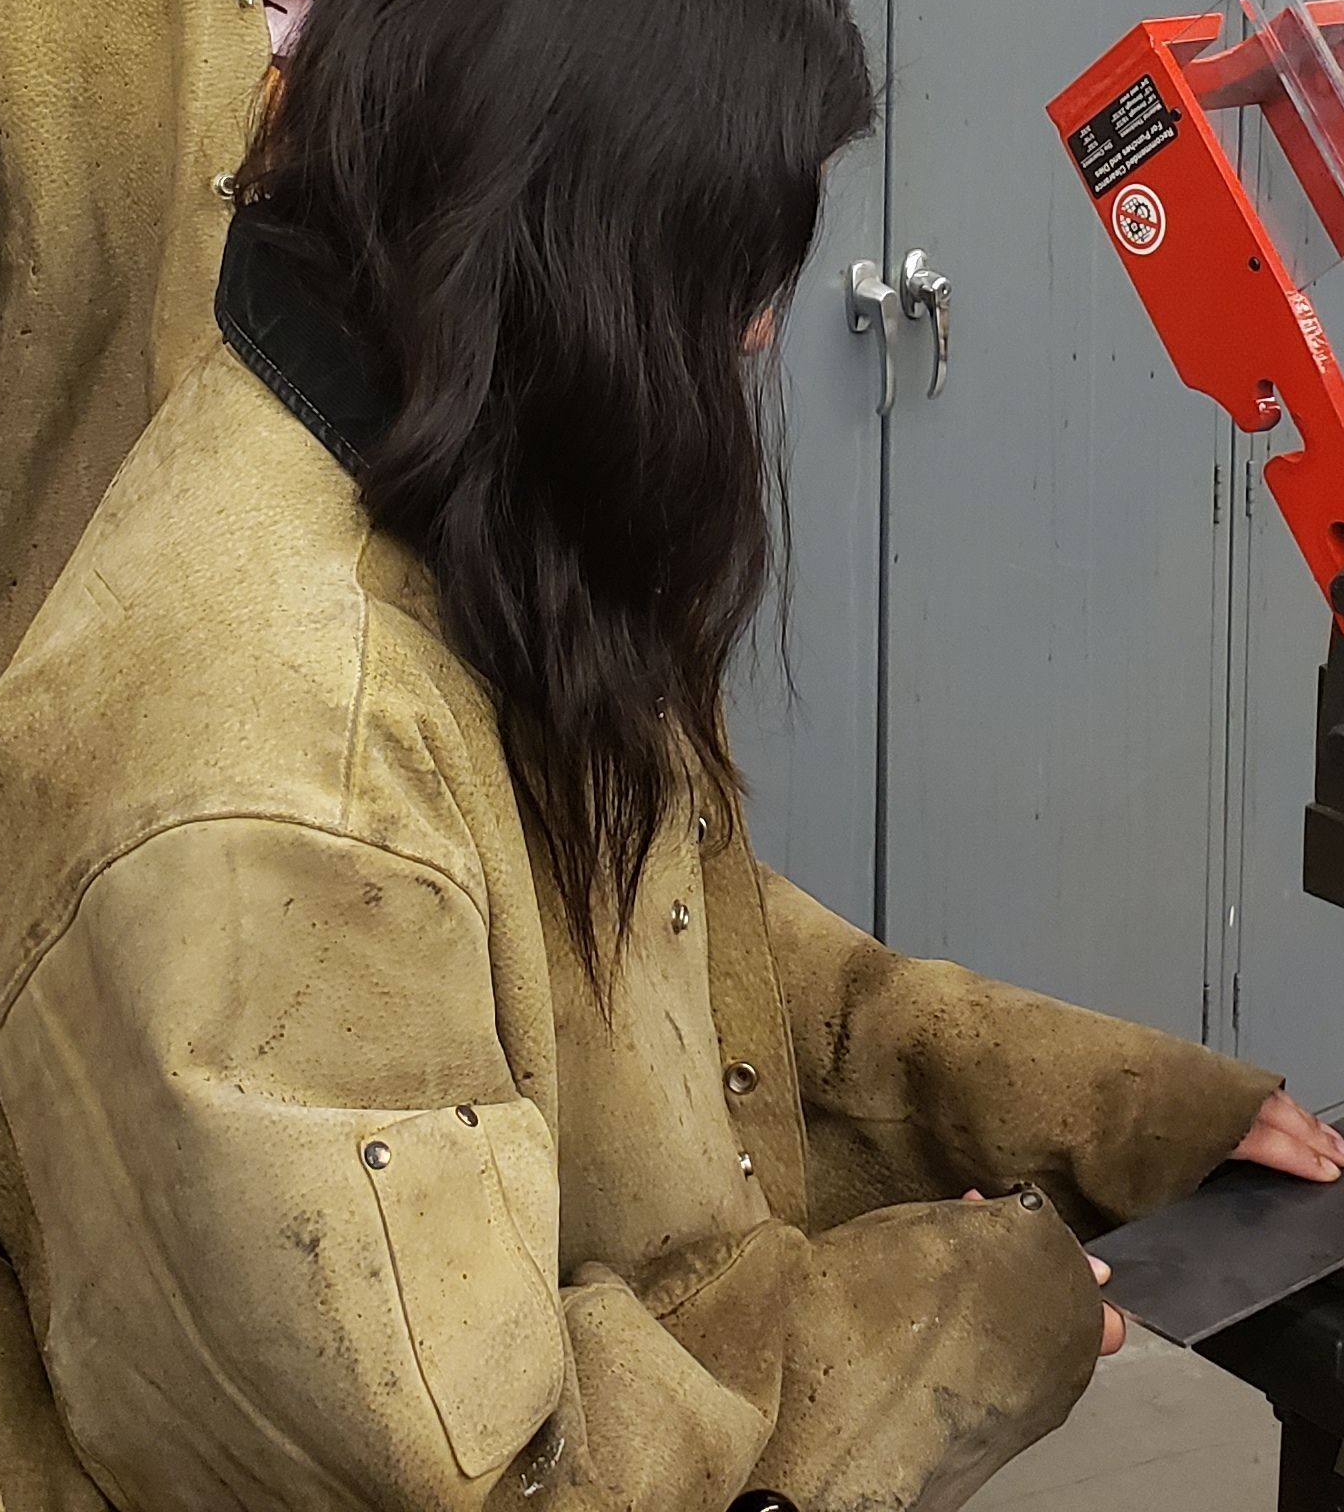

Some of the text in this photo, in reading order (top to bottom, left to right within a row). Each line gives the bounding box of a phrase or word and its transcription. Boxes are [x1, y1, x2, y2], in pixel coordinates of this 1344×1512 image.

[1095, 121, 1163, 178] For Punches and Dies
[1126, 126, 1174, 169] Recommended
[1095, 165, 1126, 193] Clearance
